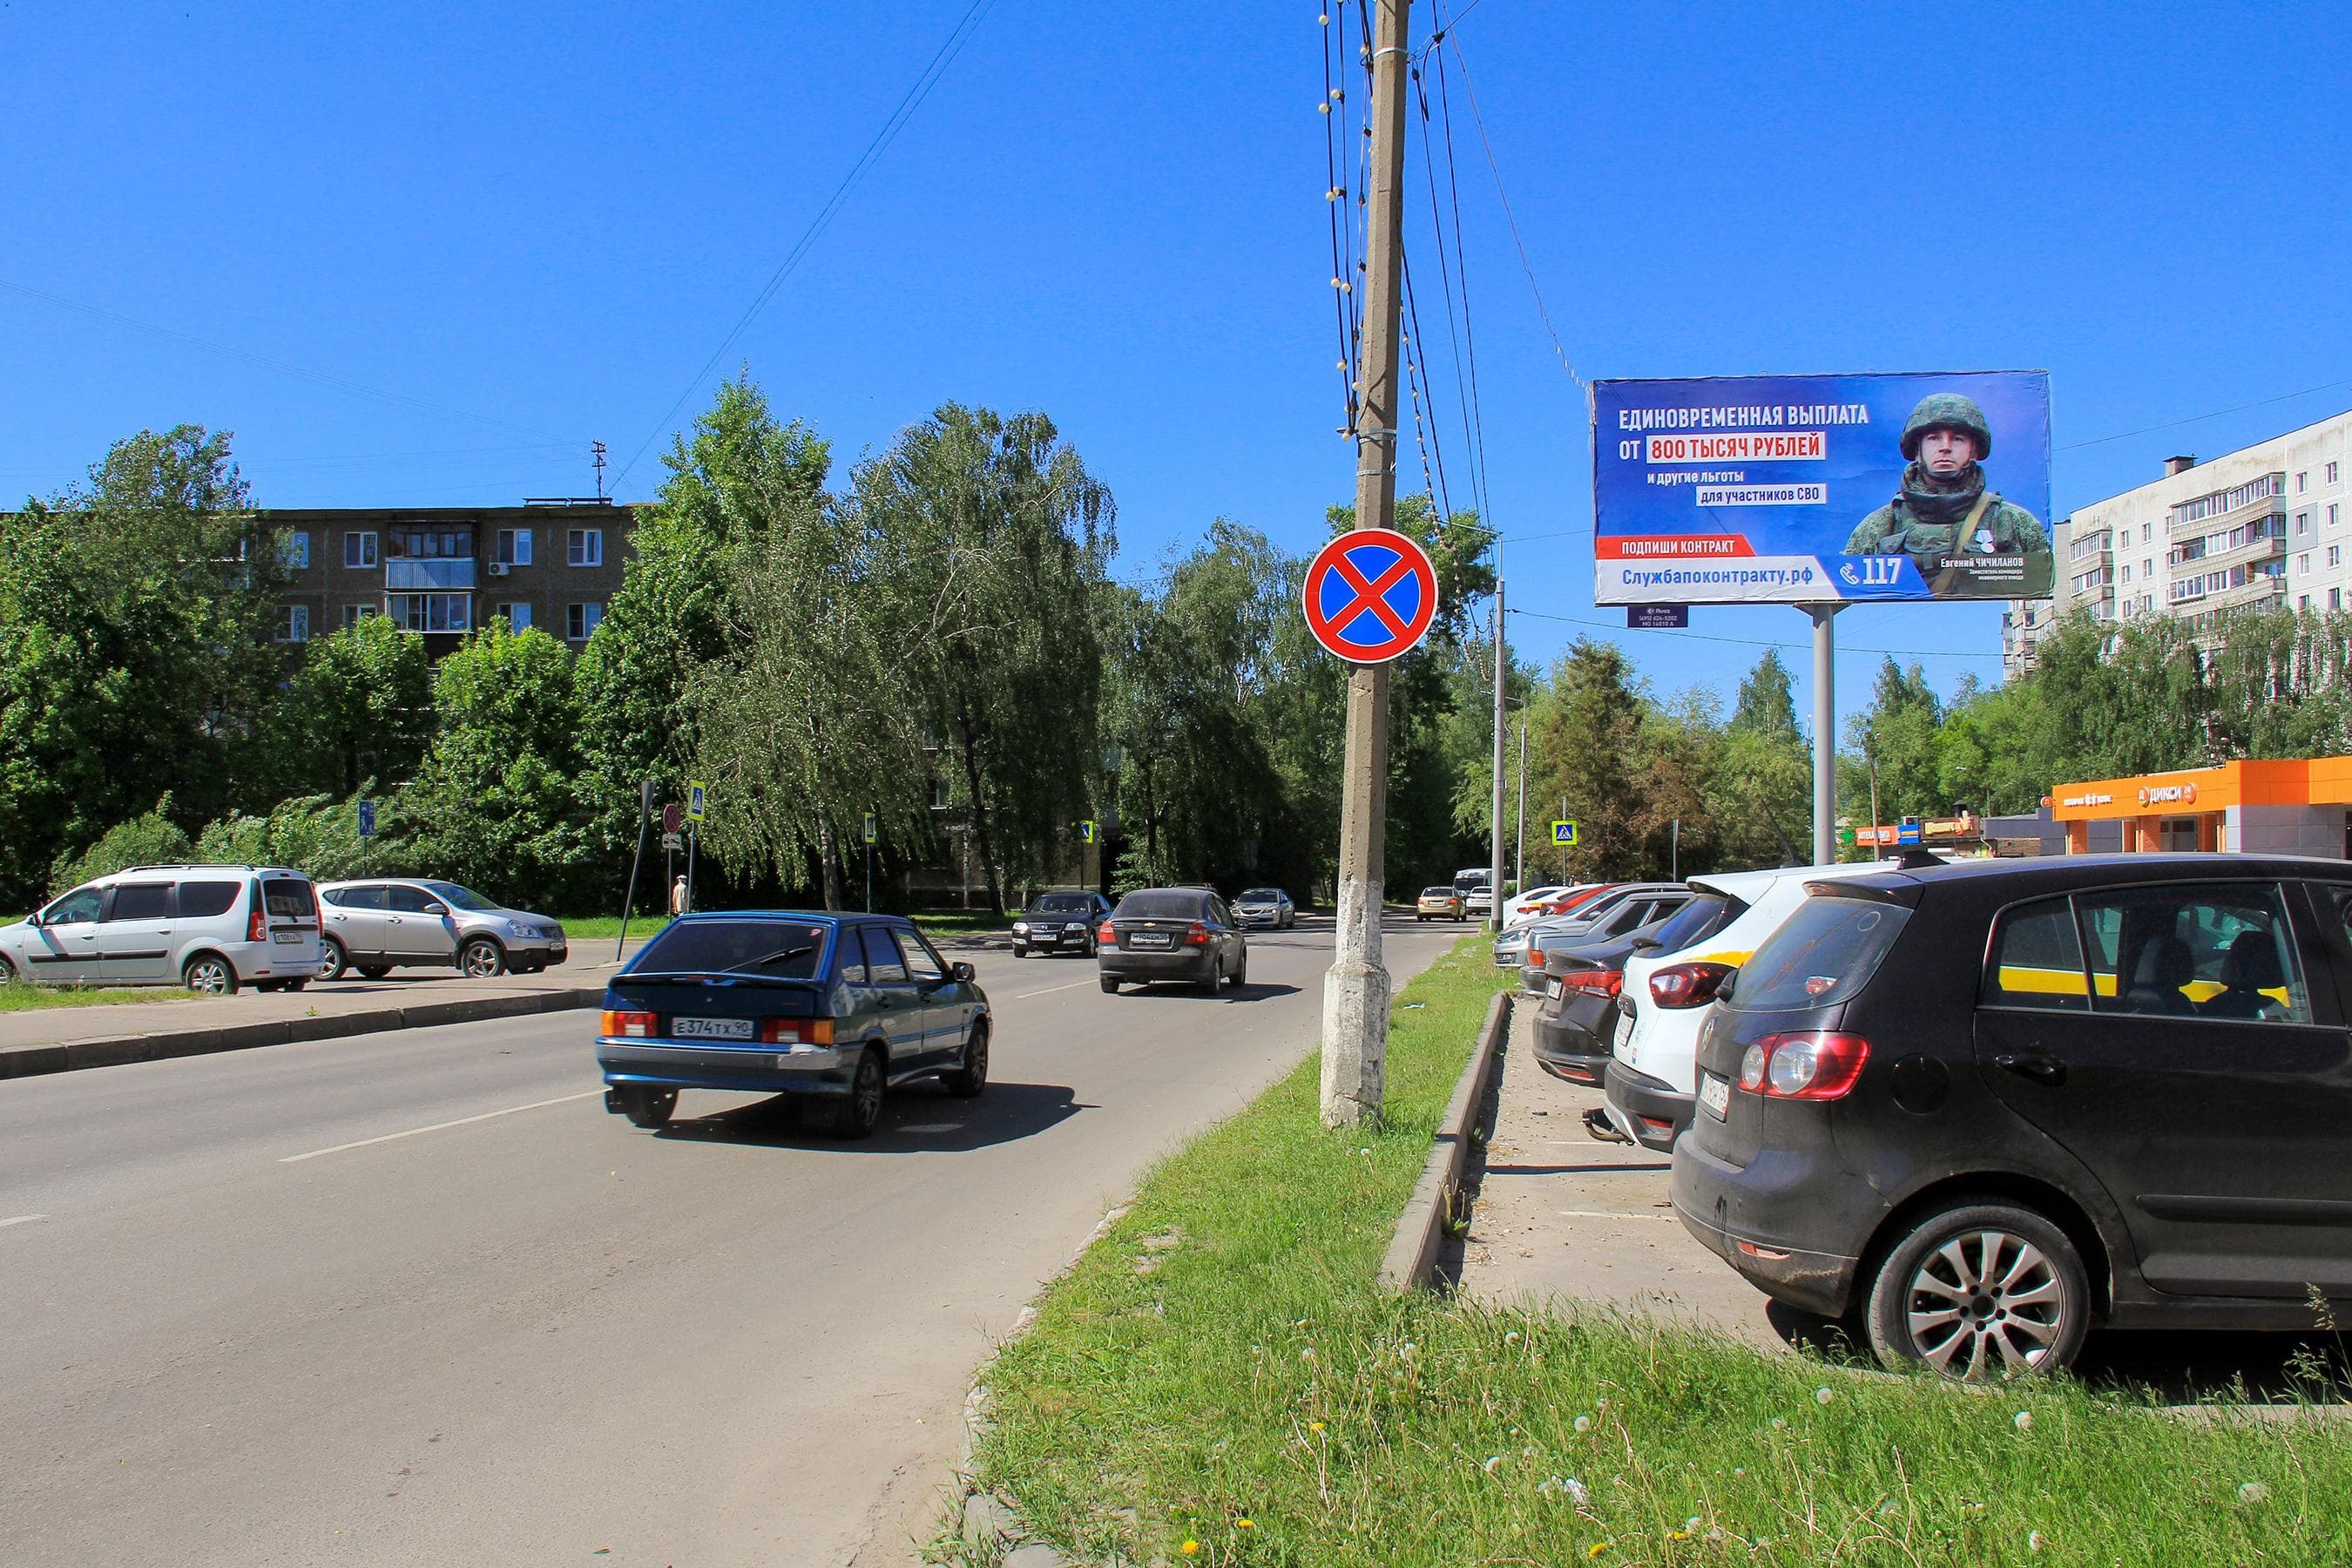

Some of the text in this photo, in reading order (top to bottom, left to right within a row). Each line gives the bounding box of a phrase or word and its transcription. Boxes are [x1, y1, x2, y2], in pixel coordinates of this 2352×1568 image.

[1619, 404, 1869, 431] ЕДИНОВРЕМЕННАЯ ВЫПЛАТА
[1619, 432, 1820, 460] ОТ 800 ТЫСЯЧ РУБЛЕЙ
[1647, 470, 1744, 486] и другие льготы
[1700, 487, 1819, 504] для участников СВО
[1621, 538, 1735, 556] ПОДПИШИ КОНТРАКТ
[1940, 557, 2024, 568] Евгений ЧИЧИЛАНОВ
[1621, 566, 1813, 587] Службапоконтракту.рф
[1862, 558, 1903, 585] 117
[2149, 785, 2182, 802] ДИКСИ
[677, 1020, 730, 1034] Е374ТХ
